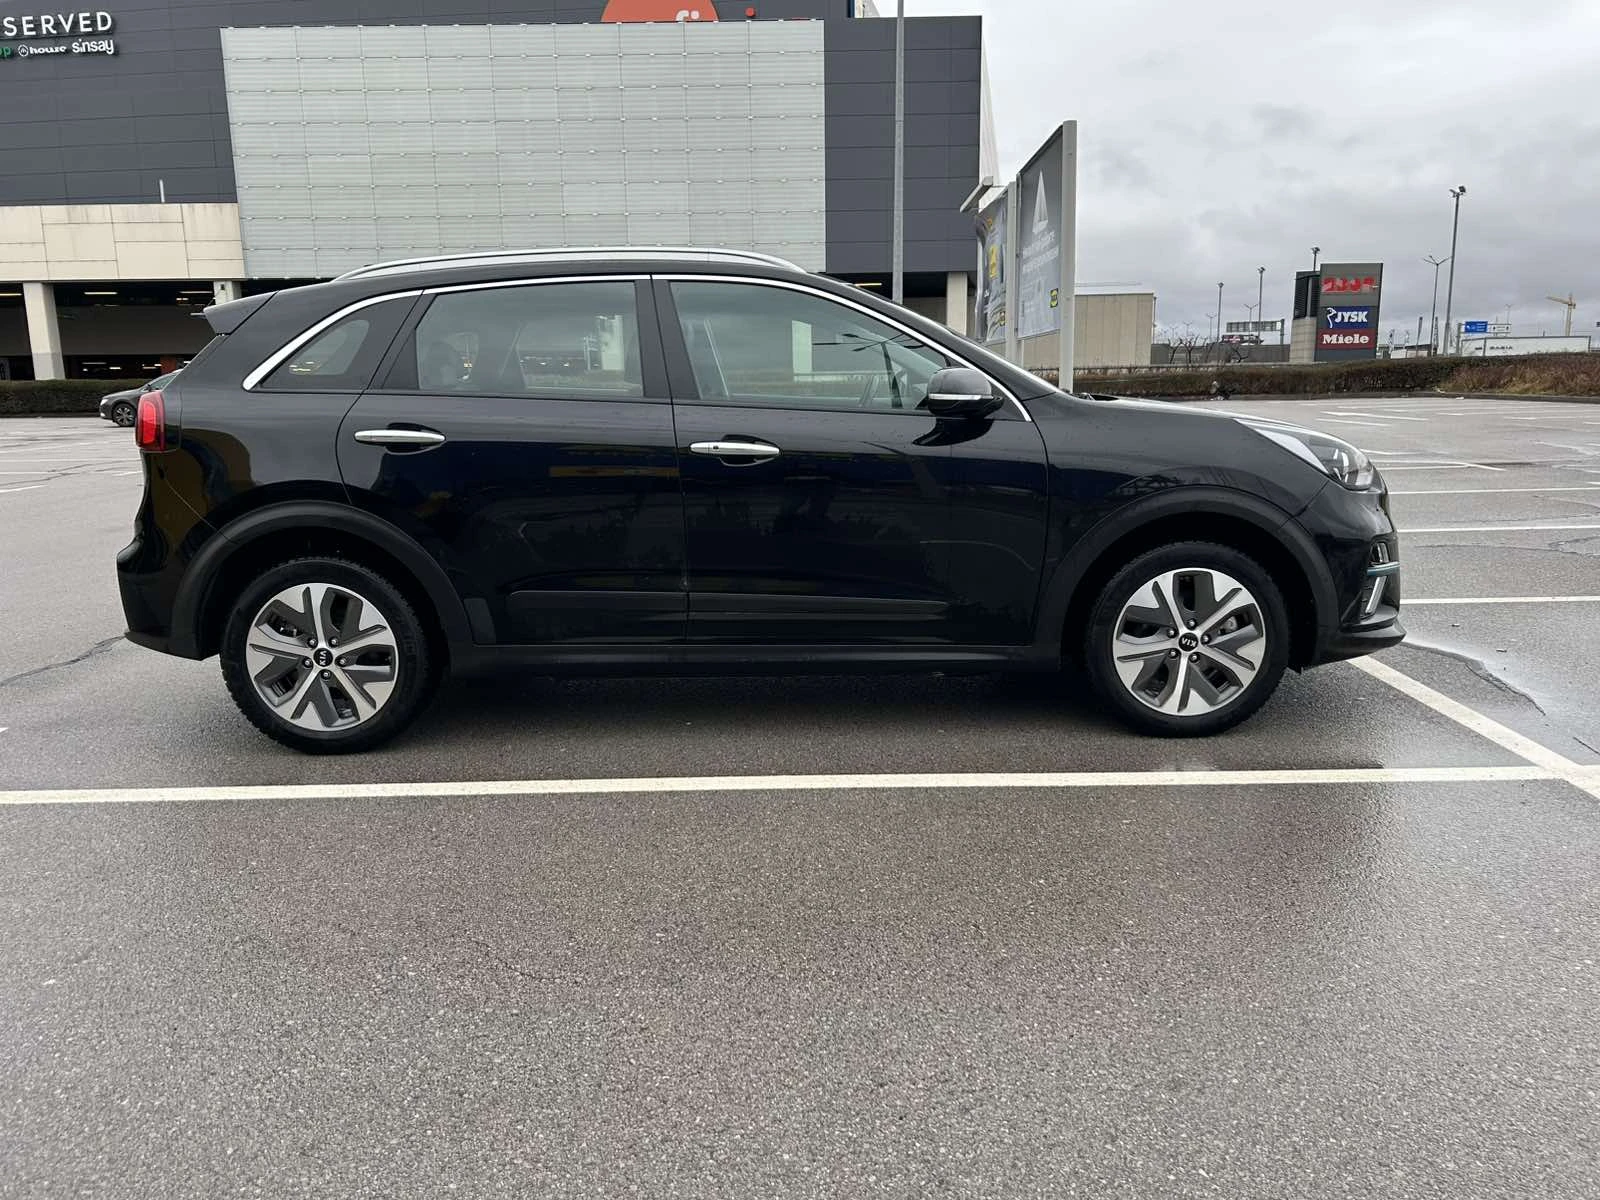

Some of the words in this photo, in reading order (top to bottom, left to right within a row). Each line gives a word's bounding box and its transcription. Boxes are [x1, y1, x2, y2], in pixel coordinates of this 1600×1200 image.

[3, 11, 112, 36] SERVED
[71, 38, 115, 55] sinsay
[1334, 311, 1368, 323] JYSK
[1322, 333, 1370, 345] Miele
